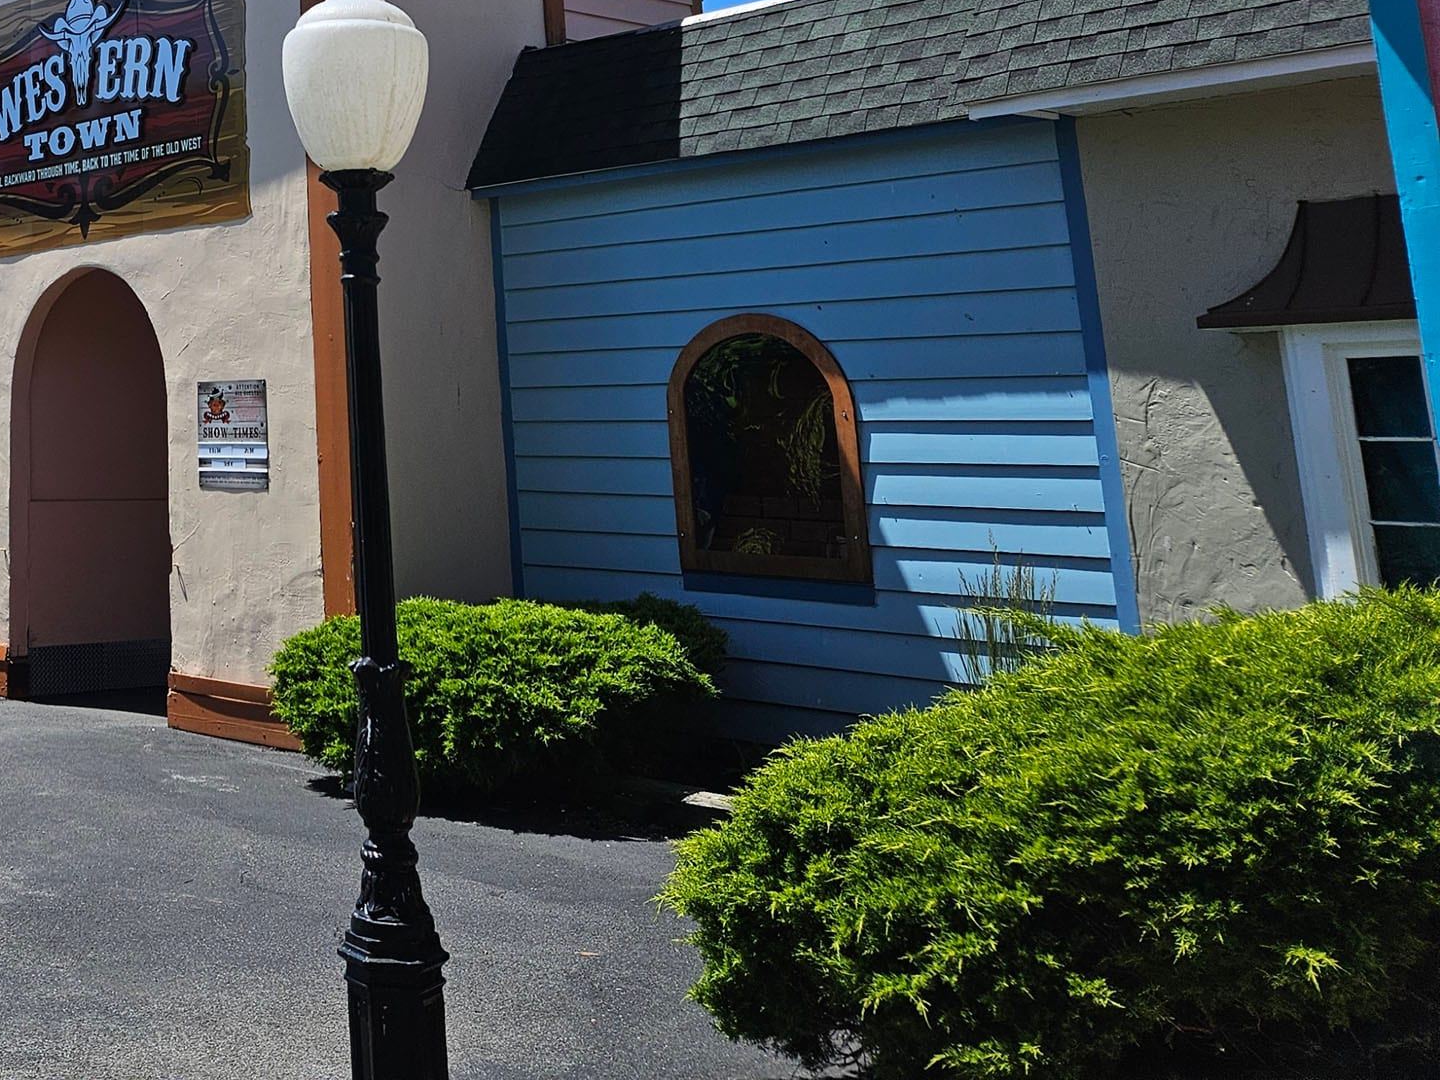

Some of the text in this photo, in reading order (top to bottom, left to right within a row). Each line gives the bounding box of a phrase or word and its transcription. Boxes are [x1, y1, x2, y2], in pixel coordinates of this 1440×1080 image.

[23, 109, 142, 161] TOWN
[4, 170, 36, 187] BACKWARD
[37, 165, 63, 180] THROUGH
[64, 161, 81, 175] TIME,
[82, 156, 99, 172] BACK
[100, 154, 109, 168] TO
[109, 152, 122, 167] THE
[123, 149, 140, 164] TIME
[141, 147, 151, 160] OF
[151, 143, 165, 158] THE
[165, 140, 180, 155] OLD
[180, 136, 202, 152] WEST
[202, 427, 228, 439] SHOW
